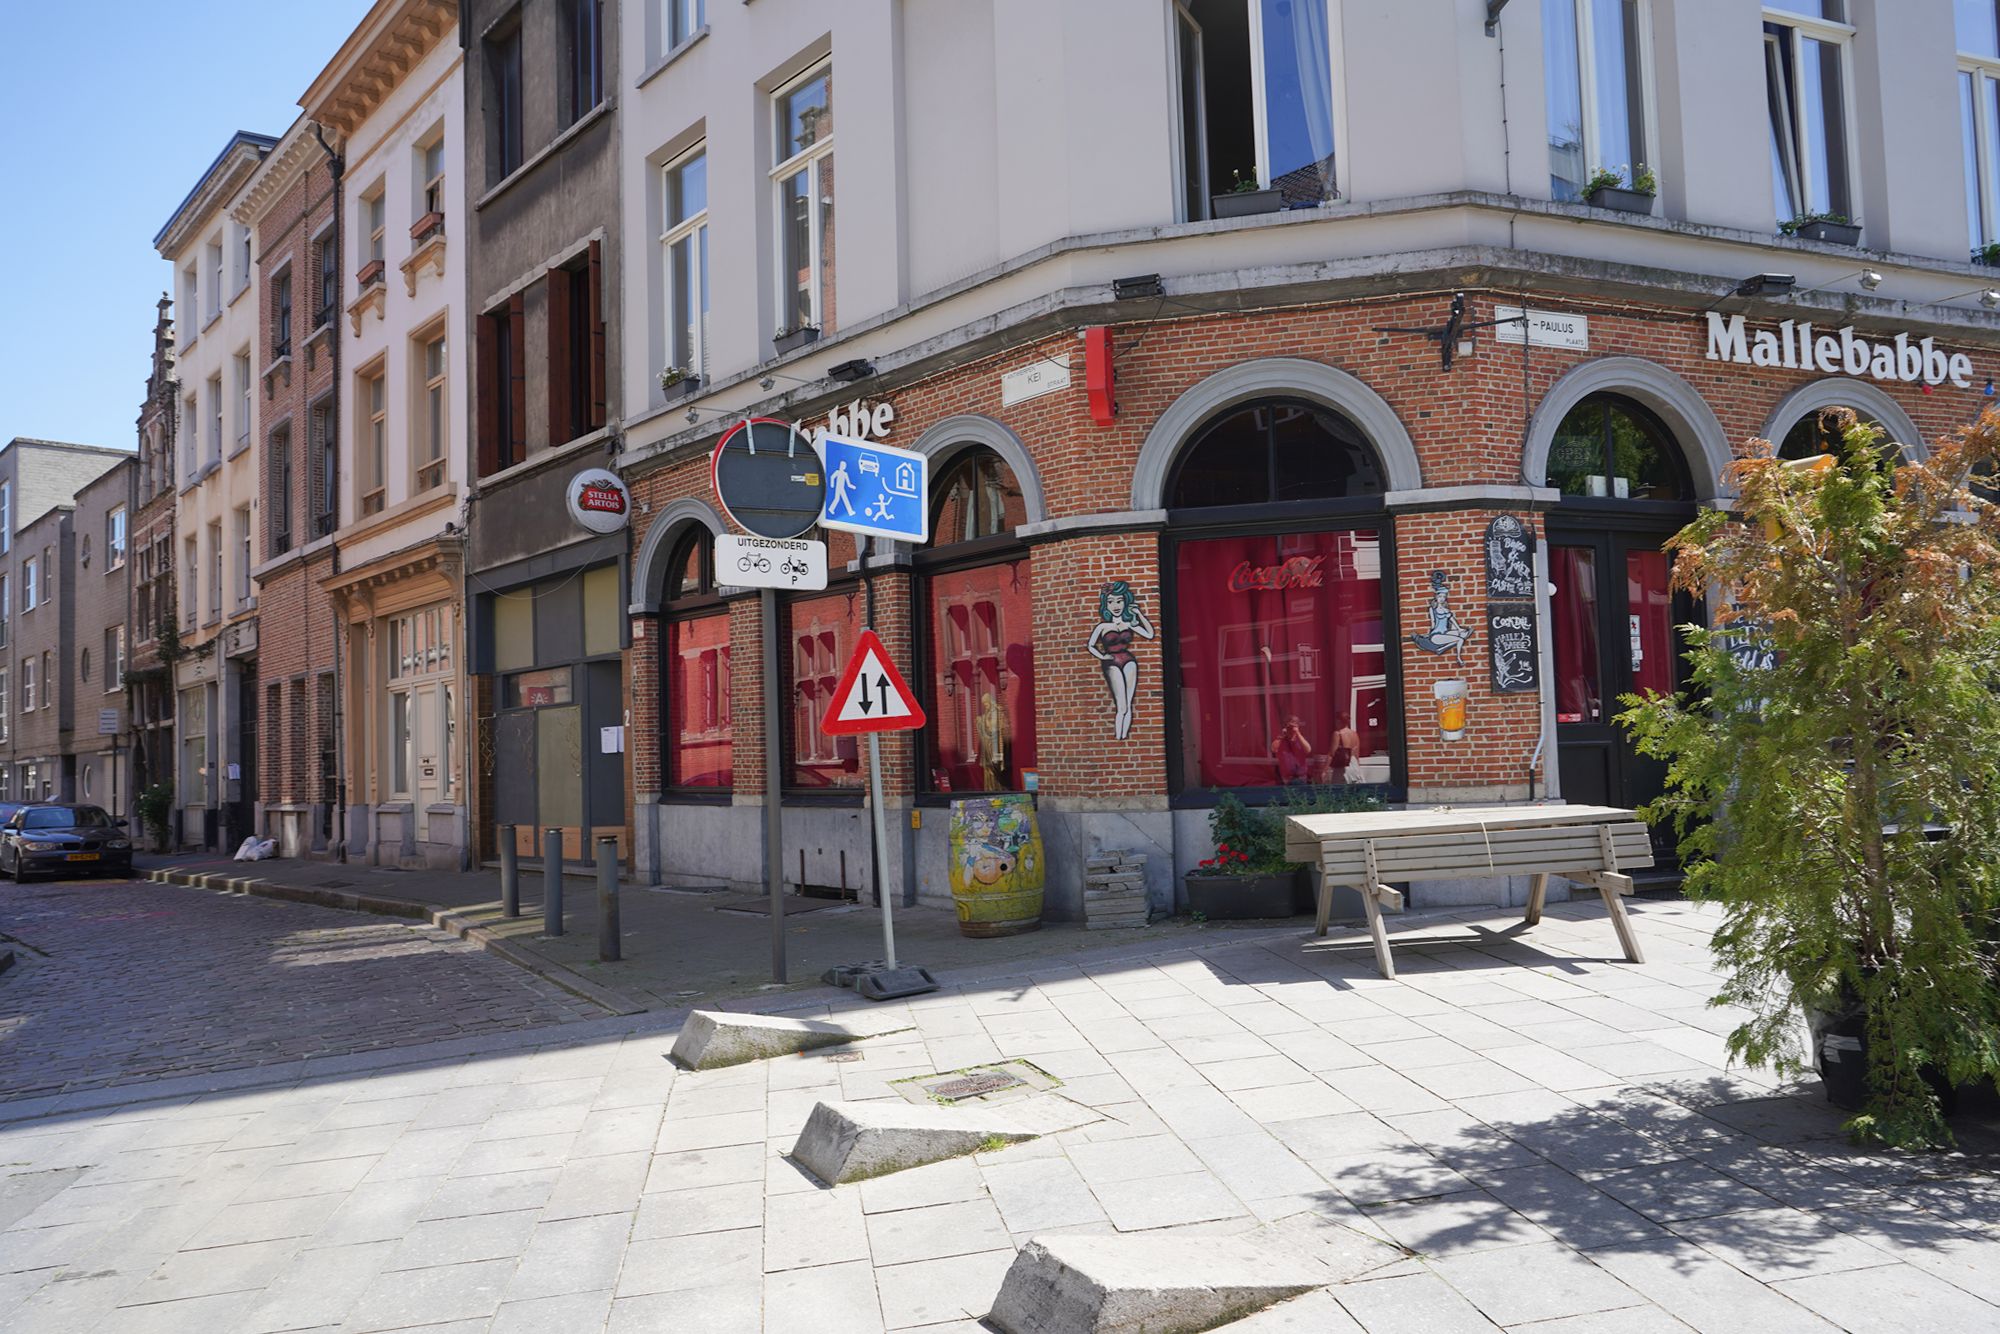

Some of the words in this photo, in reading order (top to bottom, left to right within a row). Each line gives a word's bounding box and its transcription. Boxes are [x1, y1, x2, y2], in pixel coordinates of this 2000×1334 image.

[1540, 320, 1574, 334] PAULUS
[1705, 311, 1974, 389] Mallebabbe
[1027, 371, 1041, 384] KEI
[588, 491, 619, 501] STELLA
[588, 499, 620, 509] ARTOIS
[737, 538, 808, 551] UITGEZONDERD
[791, 575, 798, 585] P
[624, 709, 631, 727] 2
